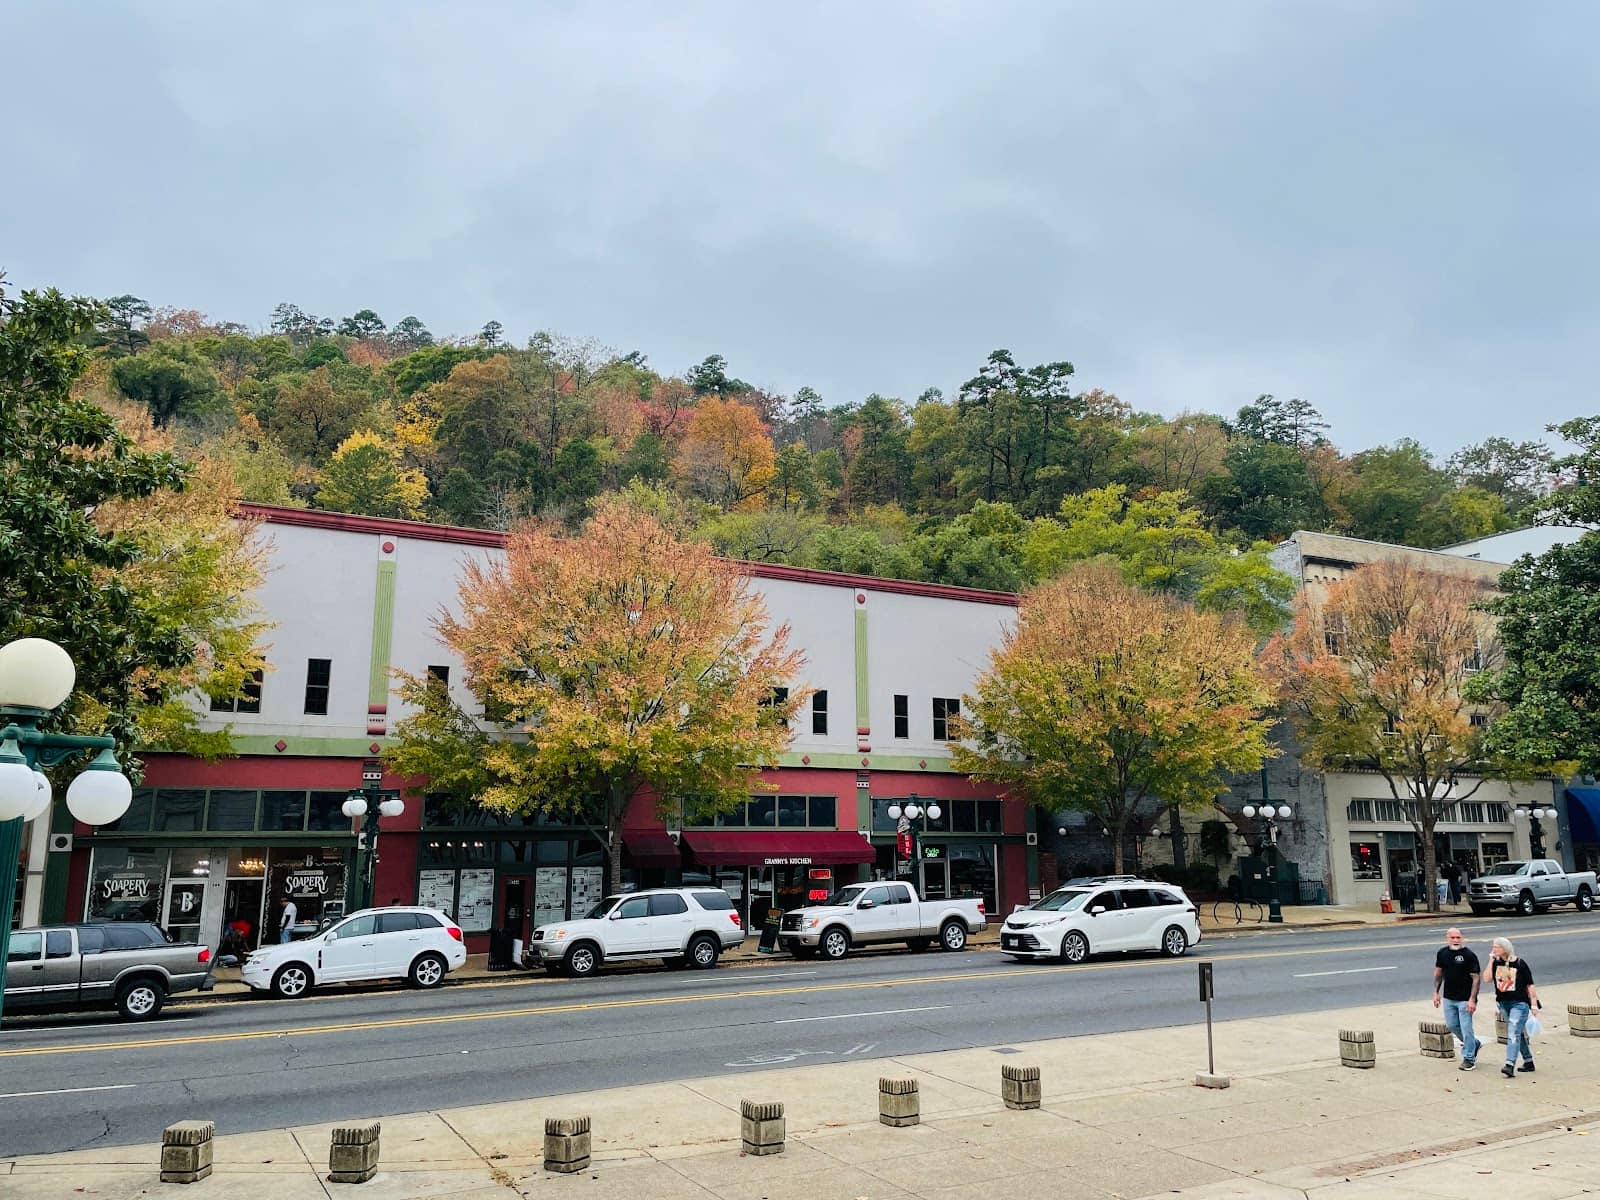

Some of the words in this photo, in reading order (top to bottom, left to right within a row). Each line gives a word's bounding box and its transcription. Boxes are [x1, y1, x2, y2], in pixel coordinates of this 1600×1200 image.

[789, 857, 811, 865] KITCHEN
[103, 879, 150, 898] SOAPERY
[285, 876, 329, 895] SOAPERY
[181, 892, 194, 912] B
